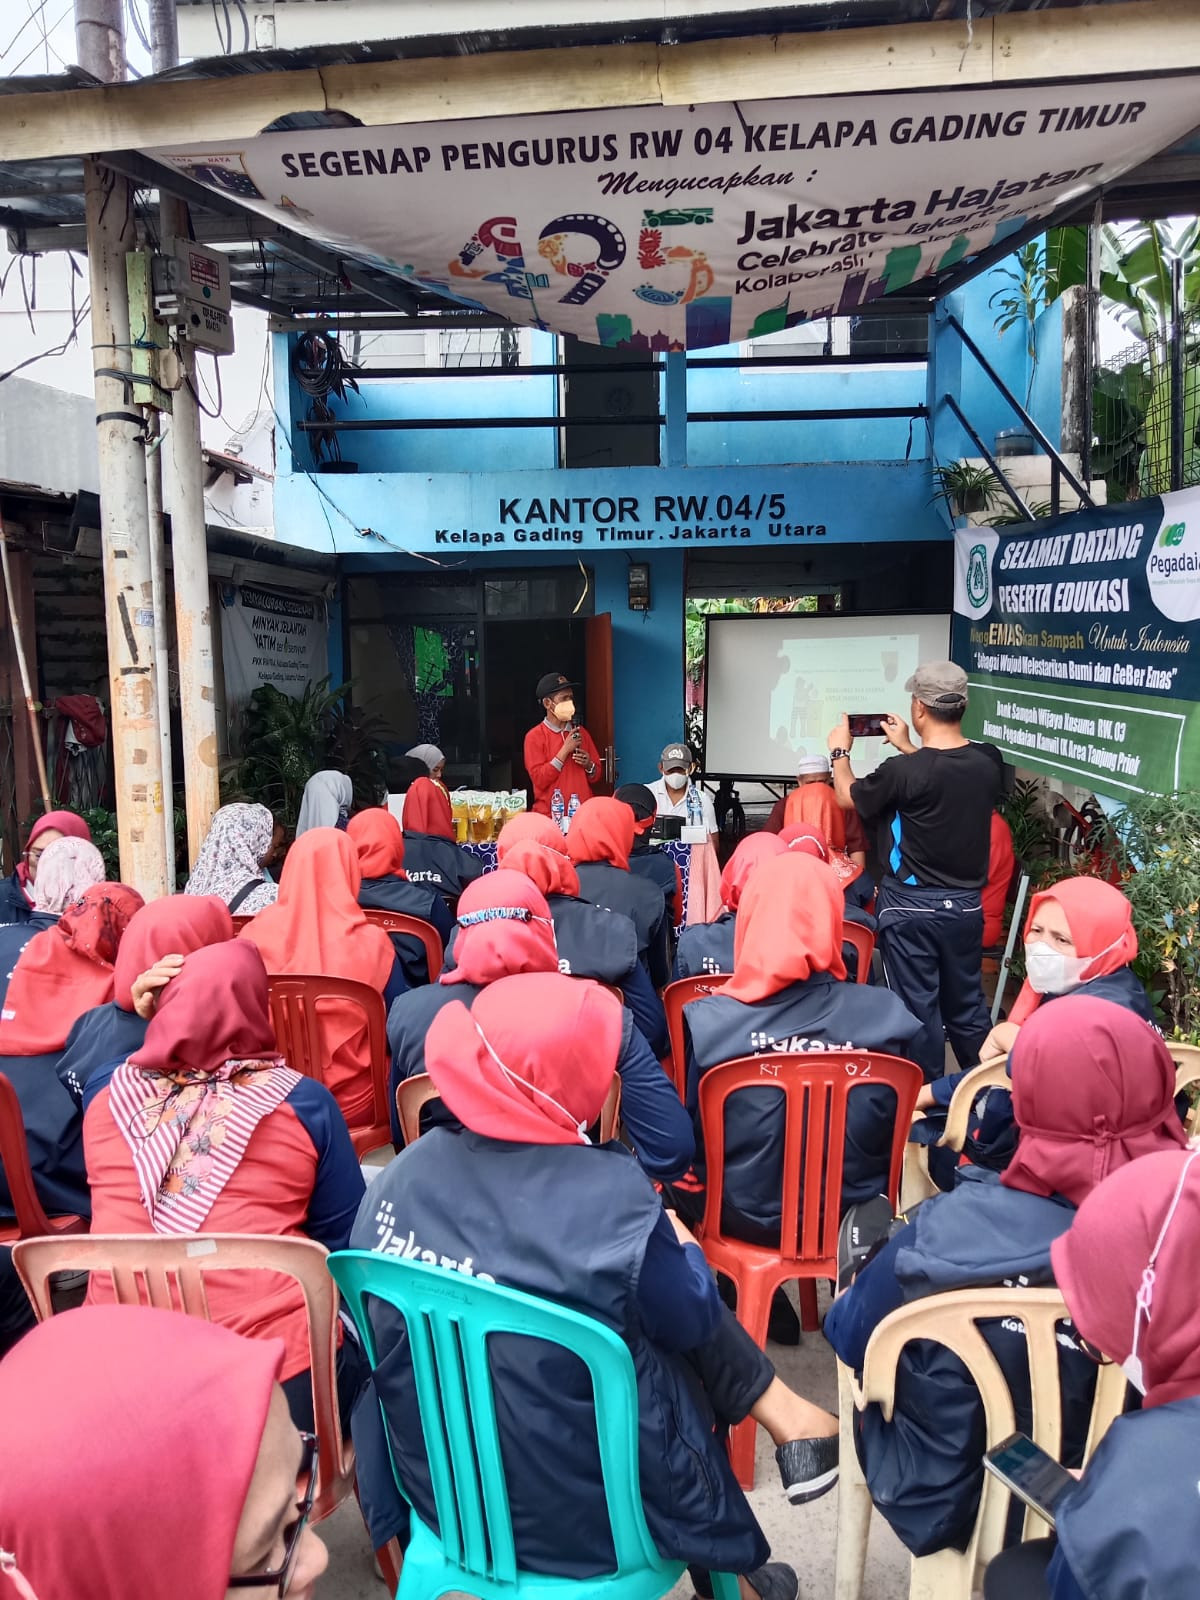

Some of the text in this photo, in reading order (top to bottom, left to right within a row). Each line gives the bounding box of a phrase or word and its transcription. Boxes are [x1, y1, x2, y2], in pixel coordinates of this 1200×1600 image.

[281, 101, 1147, 179] SEGENAP PENGURUS RW 04 KELAPA GADING TIMUR
[598, 164, 795, 196] Mengucapkan
[736, 162, 1105, 245] Jakarta Hajatan
[499, 493, 786, 525] KANTOR RW.04/5
[435, 529, 505, 546] Kelapa
[668, 524, 752, 540] Jakarta
[768, 522, 827, 537] Utara
[1000, 523, 1145, 570] SELAMAT DATANG
[998, 578, 1130, 613] PESERTA EDUKASI
[251, 615, 279, 633] MINYAK
[1041, 630, 1084, 652] Sampah
[1088, 622, 1128, 652] Untuk
[1130, 624, 1191, 654] Indonesia
[1068, 660, 1093, 682] Bumi
[1094, 662, 1111, 684] dan
[1112, 663, 1145, 687] GeBer
[405, 869, 443, 883] karta
[759, 1057, 872, 1078] RT 02
